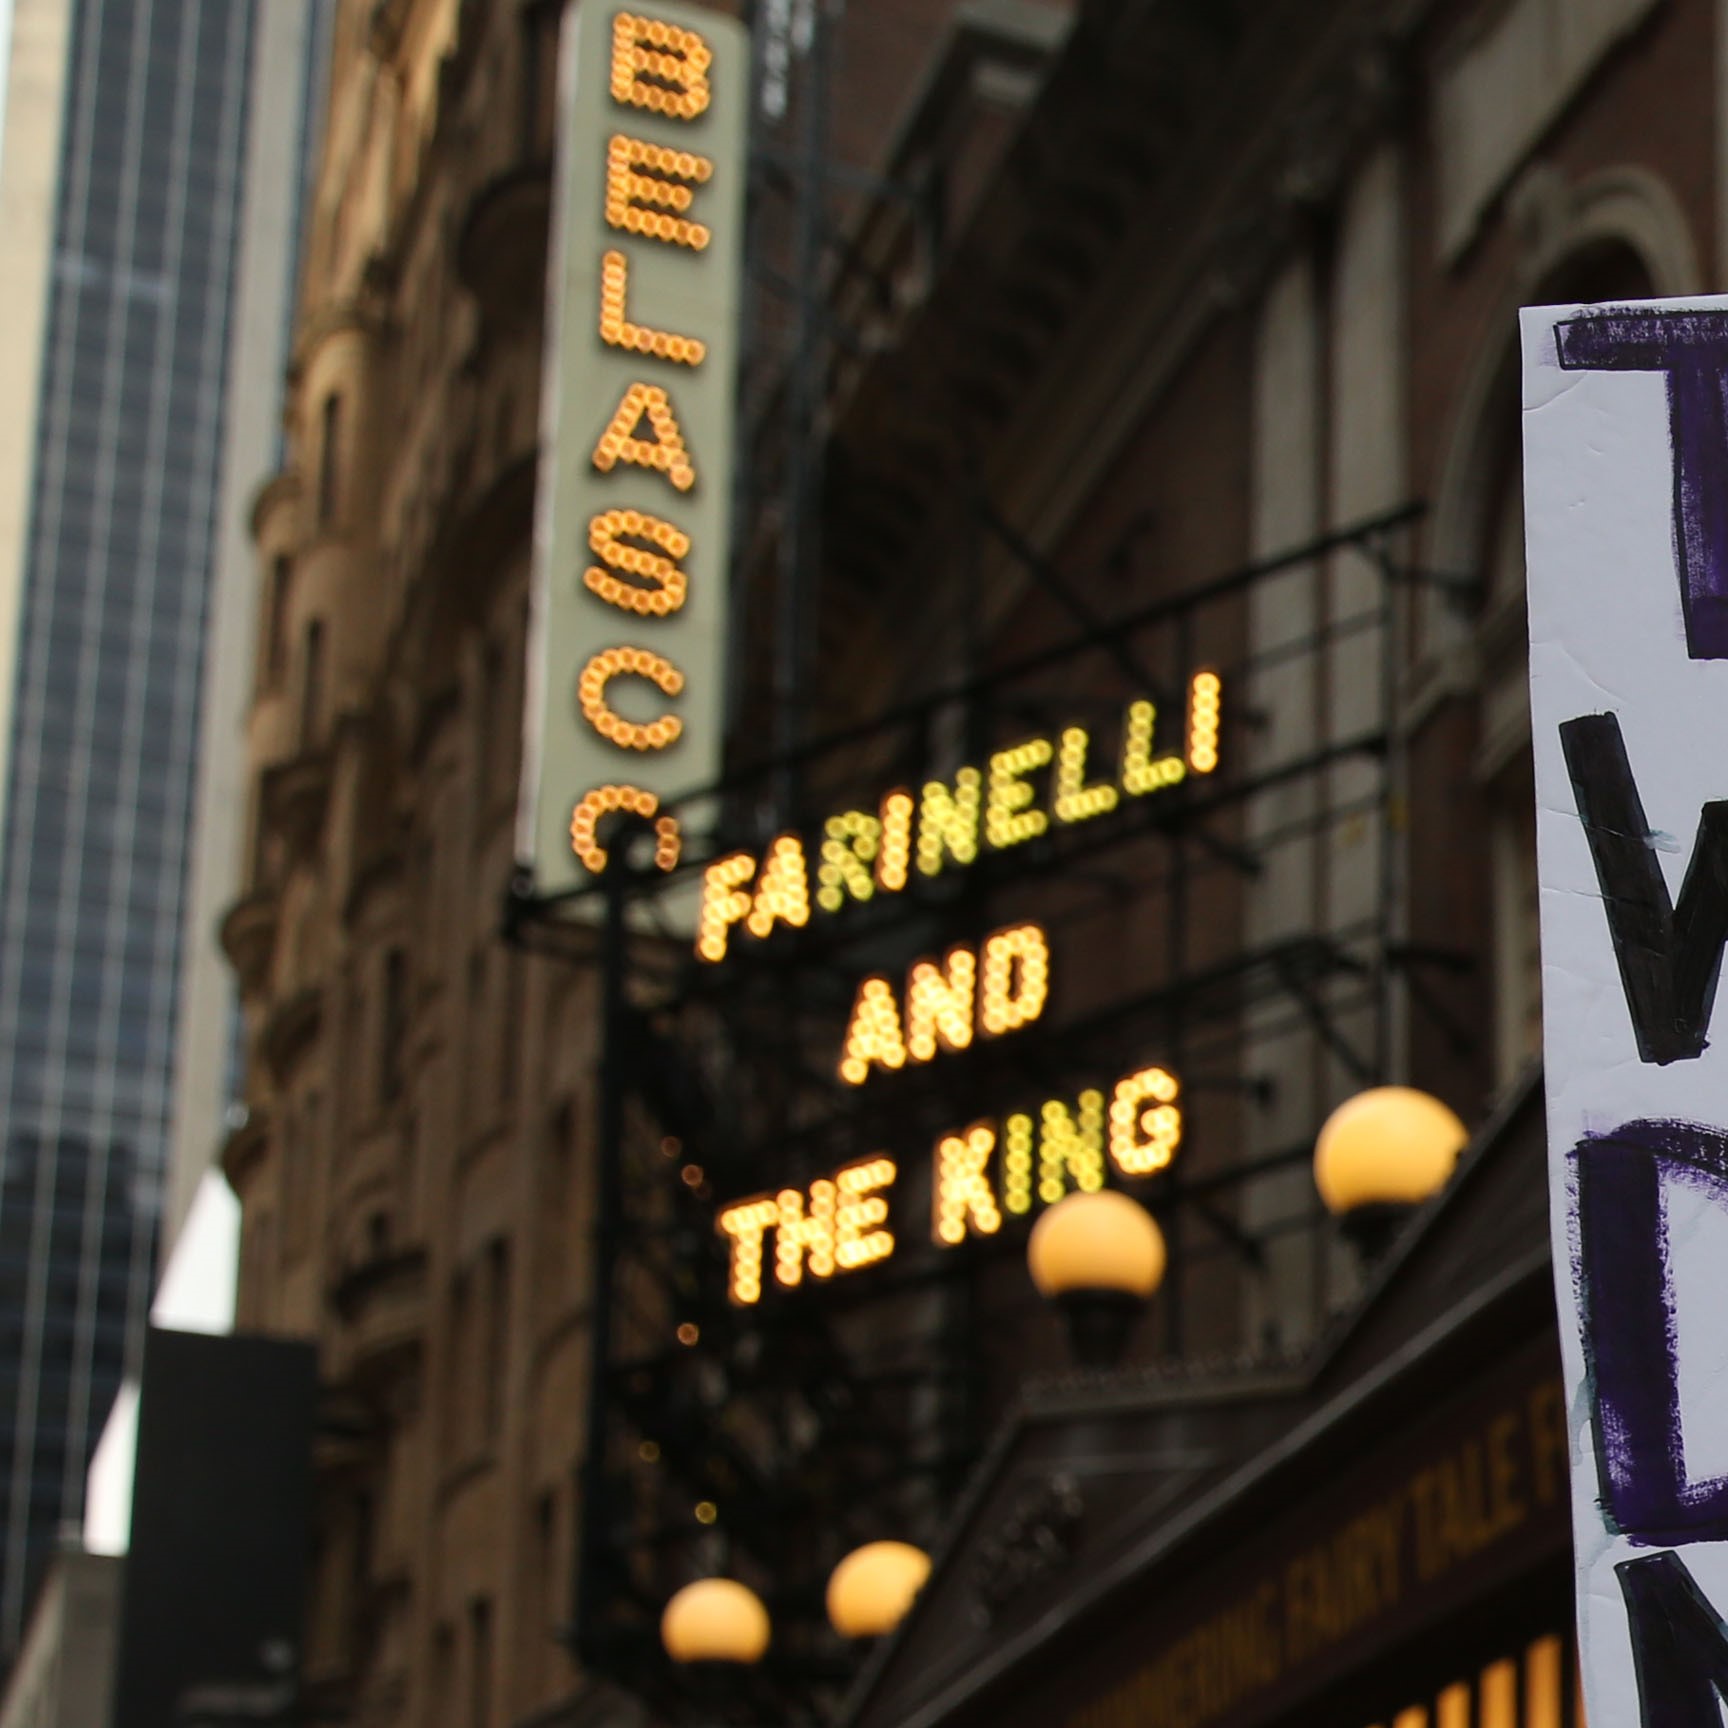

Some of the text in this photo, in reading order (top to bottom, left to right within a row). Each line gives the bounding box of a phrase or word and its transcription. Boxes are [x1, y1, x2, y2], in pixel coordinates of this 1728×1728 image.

[698, 670, 1222, 964] FARINELLI
[838, 922, 1050, 1086] AND
[718, 1065, 1182, 1304] THE KING
[1408, 1408, 1528, 1584] TALE
